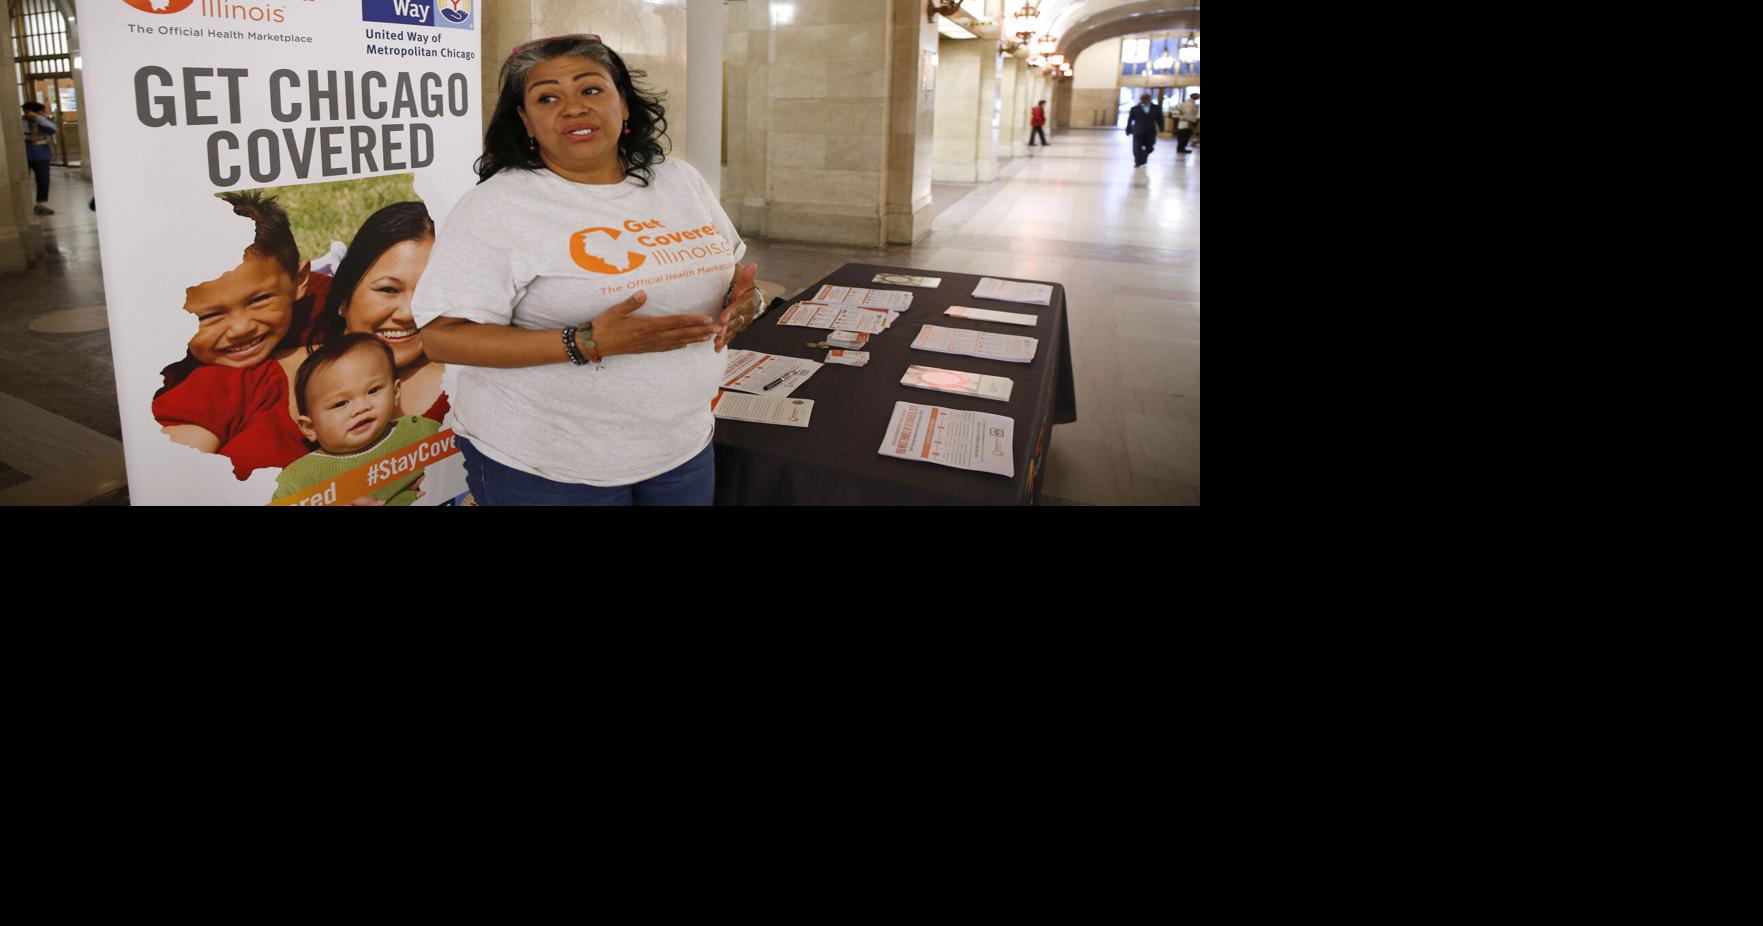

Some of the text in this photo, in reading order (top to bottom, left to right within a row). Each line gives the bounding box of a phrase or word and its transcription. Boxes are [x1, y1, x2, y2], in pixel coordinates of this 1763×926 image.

[201, 0, 285, 23] Illinois
[393, 0, 430, 23] Way
[127, 23, 313, 43] The Official Health Marketplace
[365, 29, 442, 44] United Way of
[366, 44, 475, 60] Metropolitan Chicago
[133, 65, 469, 128] GET CHICAGO
[206, 122, 435, 188] COVERED
[623, 219, 666, 232] Get
[600, 284, 624, 296] The
[627, 277, 663, 289] Official
[665, 269, 694, 281] Health
